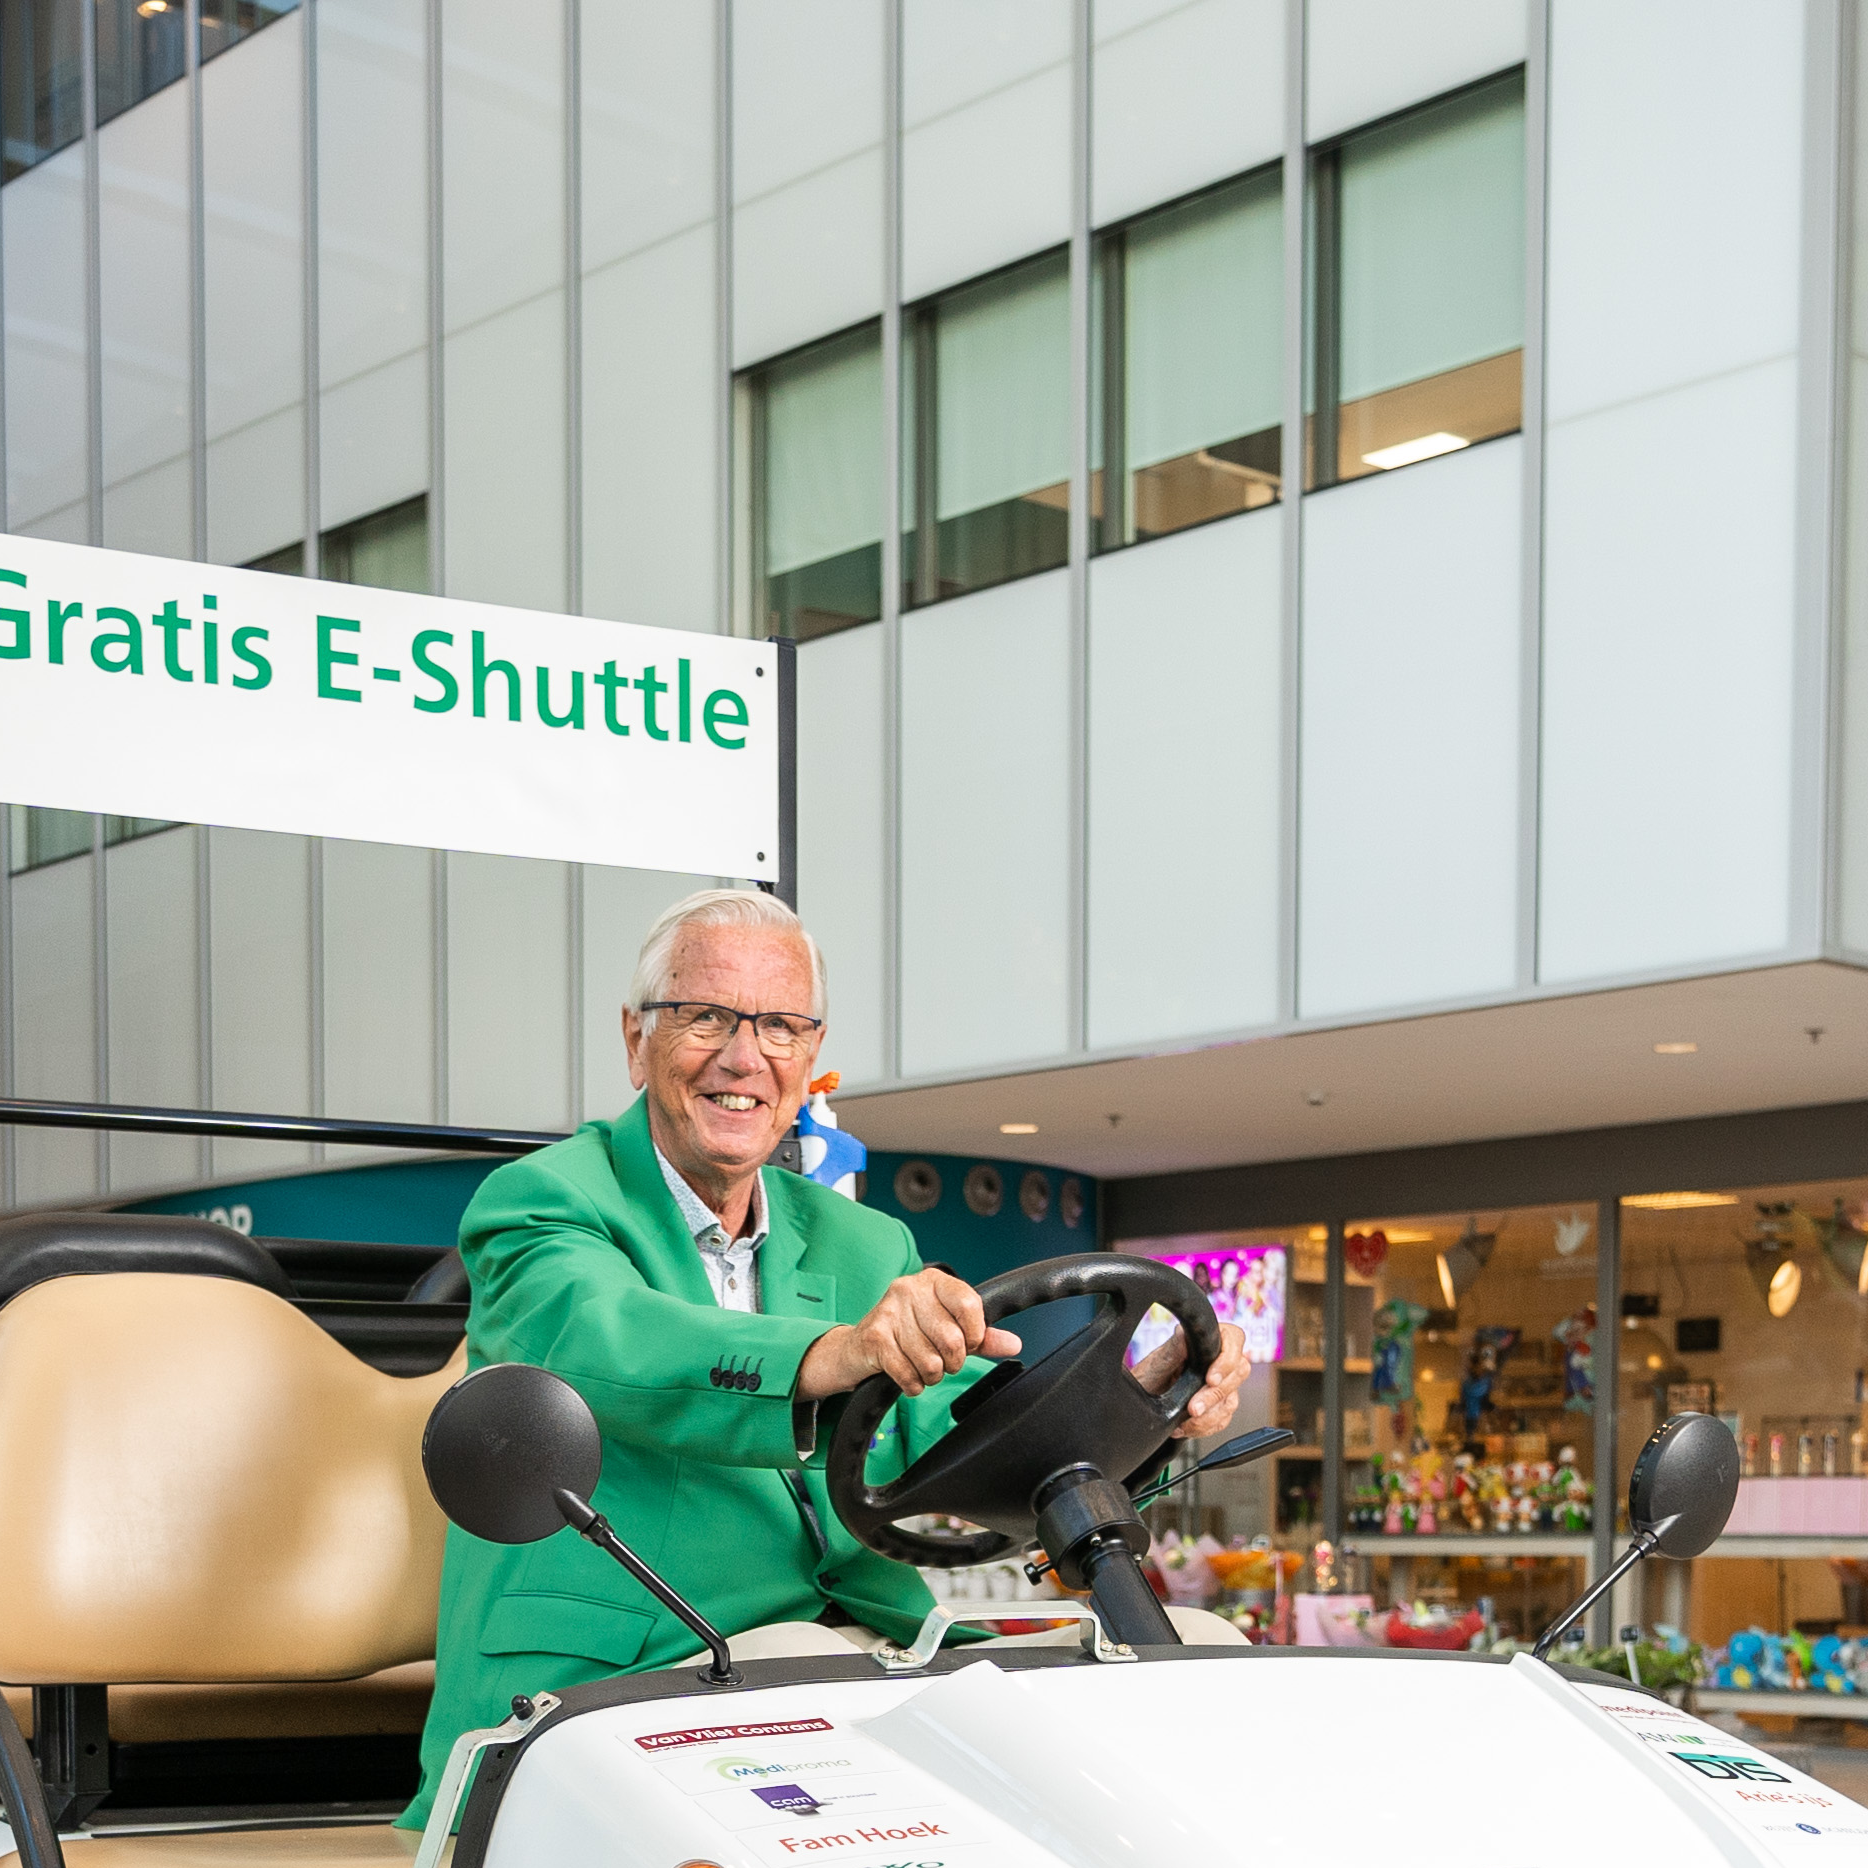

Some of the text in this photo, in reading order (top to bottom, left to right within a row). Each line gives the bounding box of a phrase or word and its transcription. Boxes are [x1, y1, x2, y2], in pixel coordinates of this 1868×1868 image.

[316, 613, 750, 751] E-Shuttle
[641, 1731, 685, 1747] Van
[685, 1727, 734, 1740] Vliet
[736, 1720, 826, 1736] Contrans
[733, 1758, 852, 1777] Mediproma
[770, 1796, 813, 1807] cam
[779, 1821, 950, 1853] Fam Hoek
